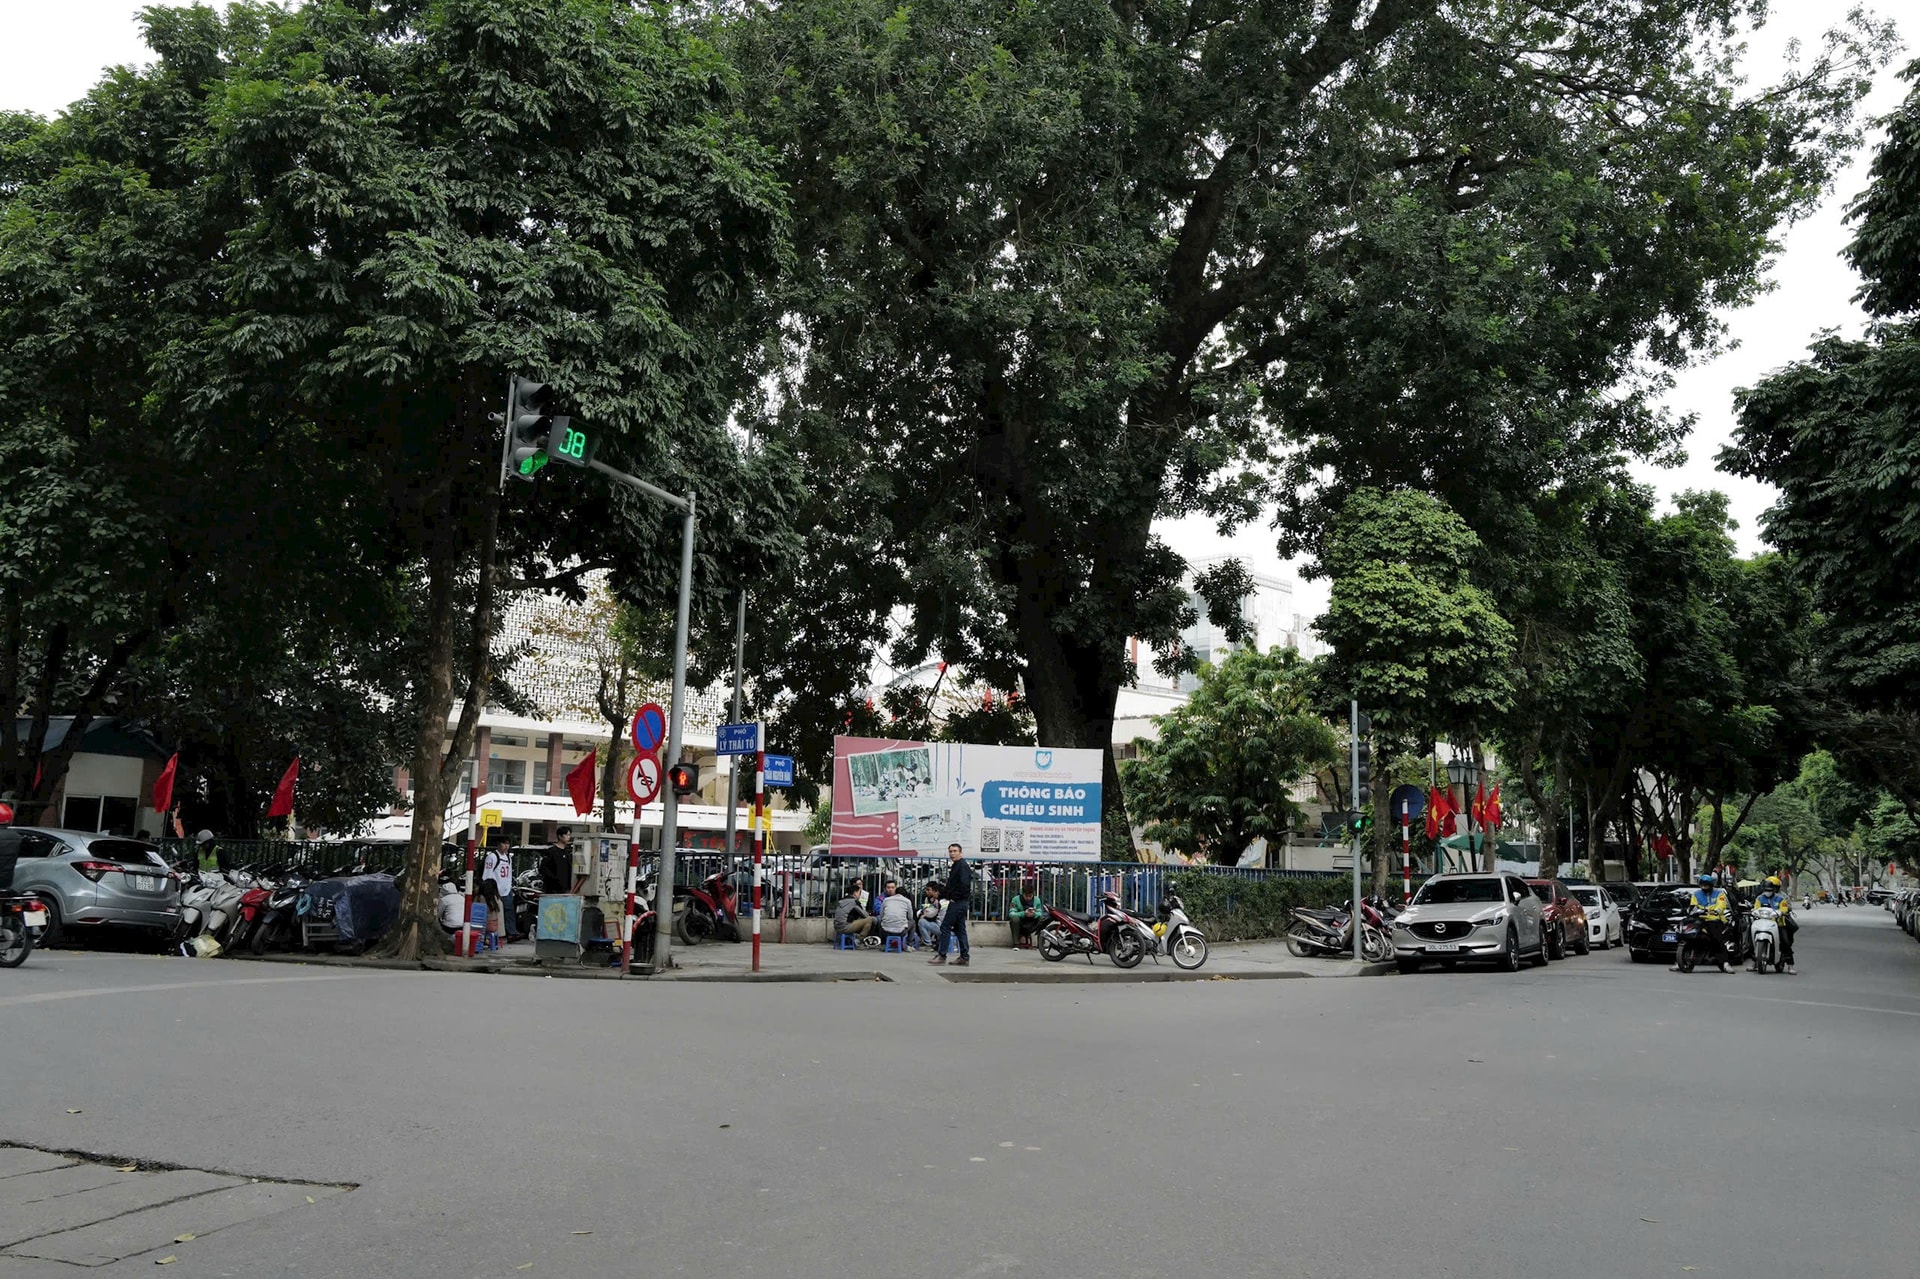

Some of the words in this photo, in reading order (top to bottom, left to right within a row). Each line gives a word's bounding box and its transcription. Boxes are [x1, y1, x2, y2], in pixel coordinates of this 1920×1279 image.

[719, 738, 728, 751] LÝ
[729, 737, 744, 751] THÁI
[999, 785, 1051, 799] THÔNG
[1054, 786, 1086, 800] BÁO
[1000, 802, 1045, 816] CHIÊU
[1048, 805, 1084, 817] SINH
